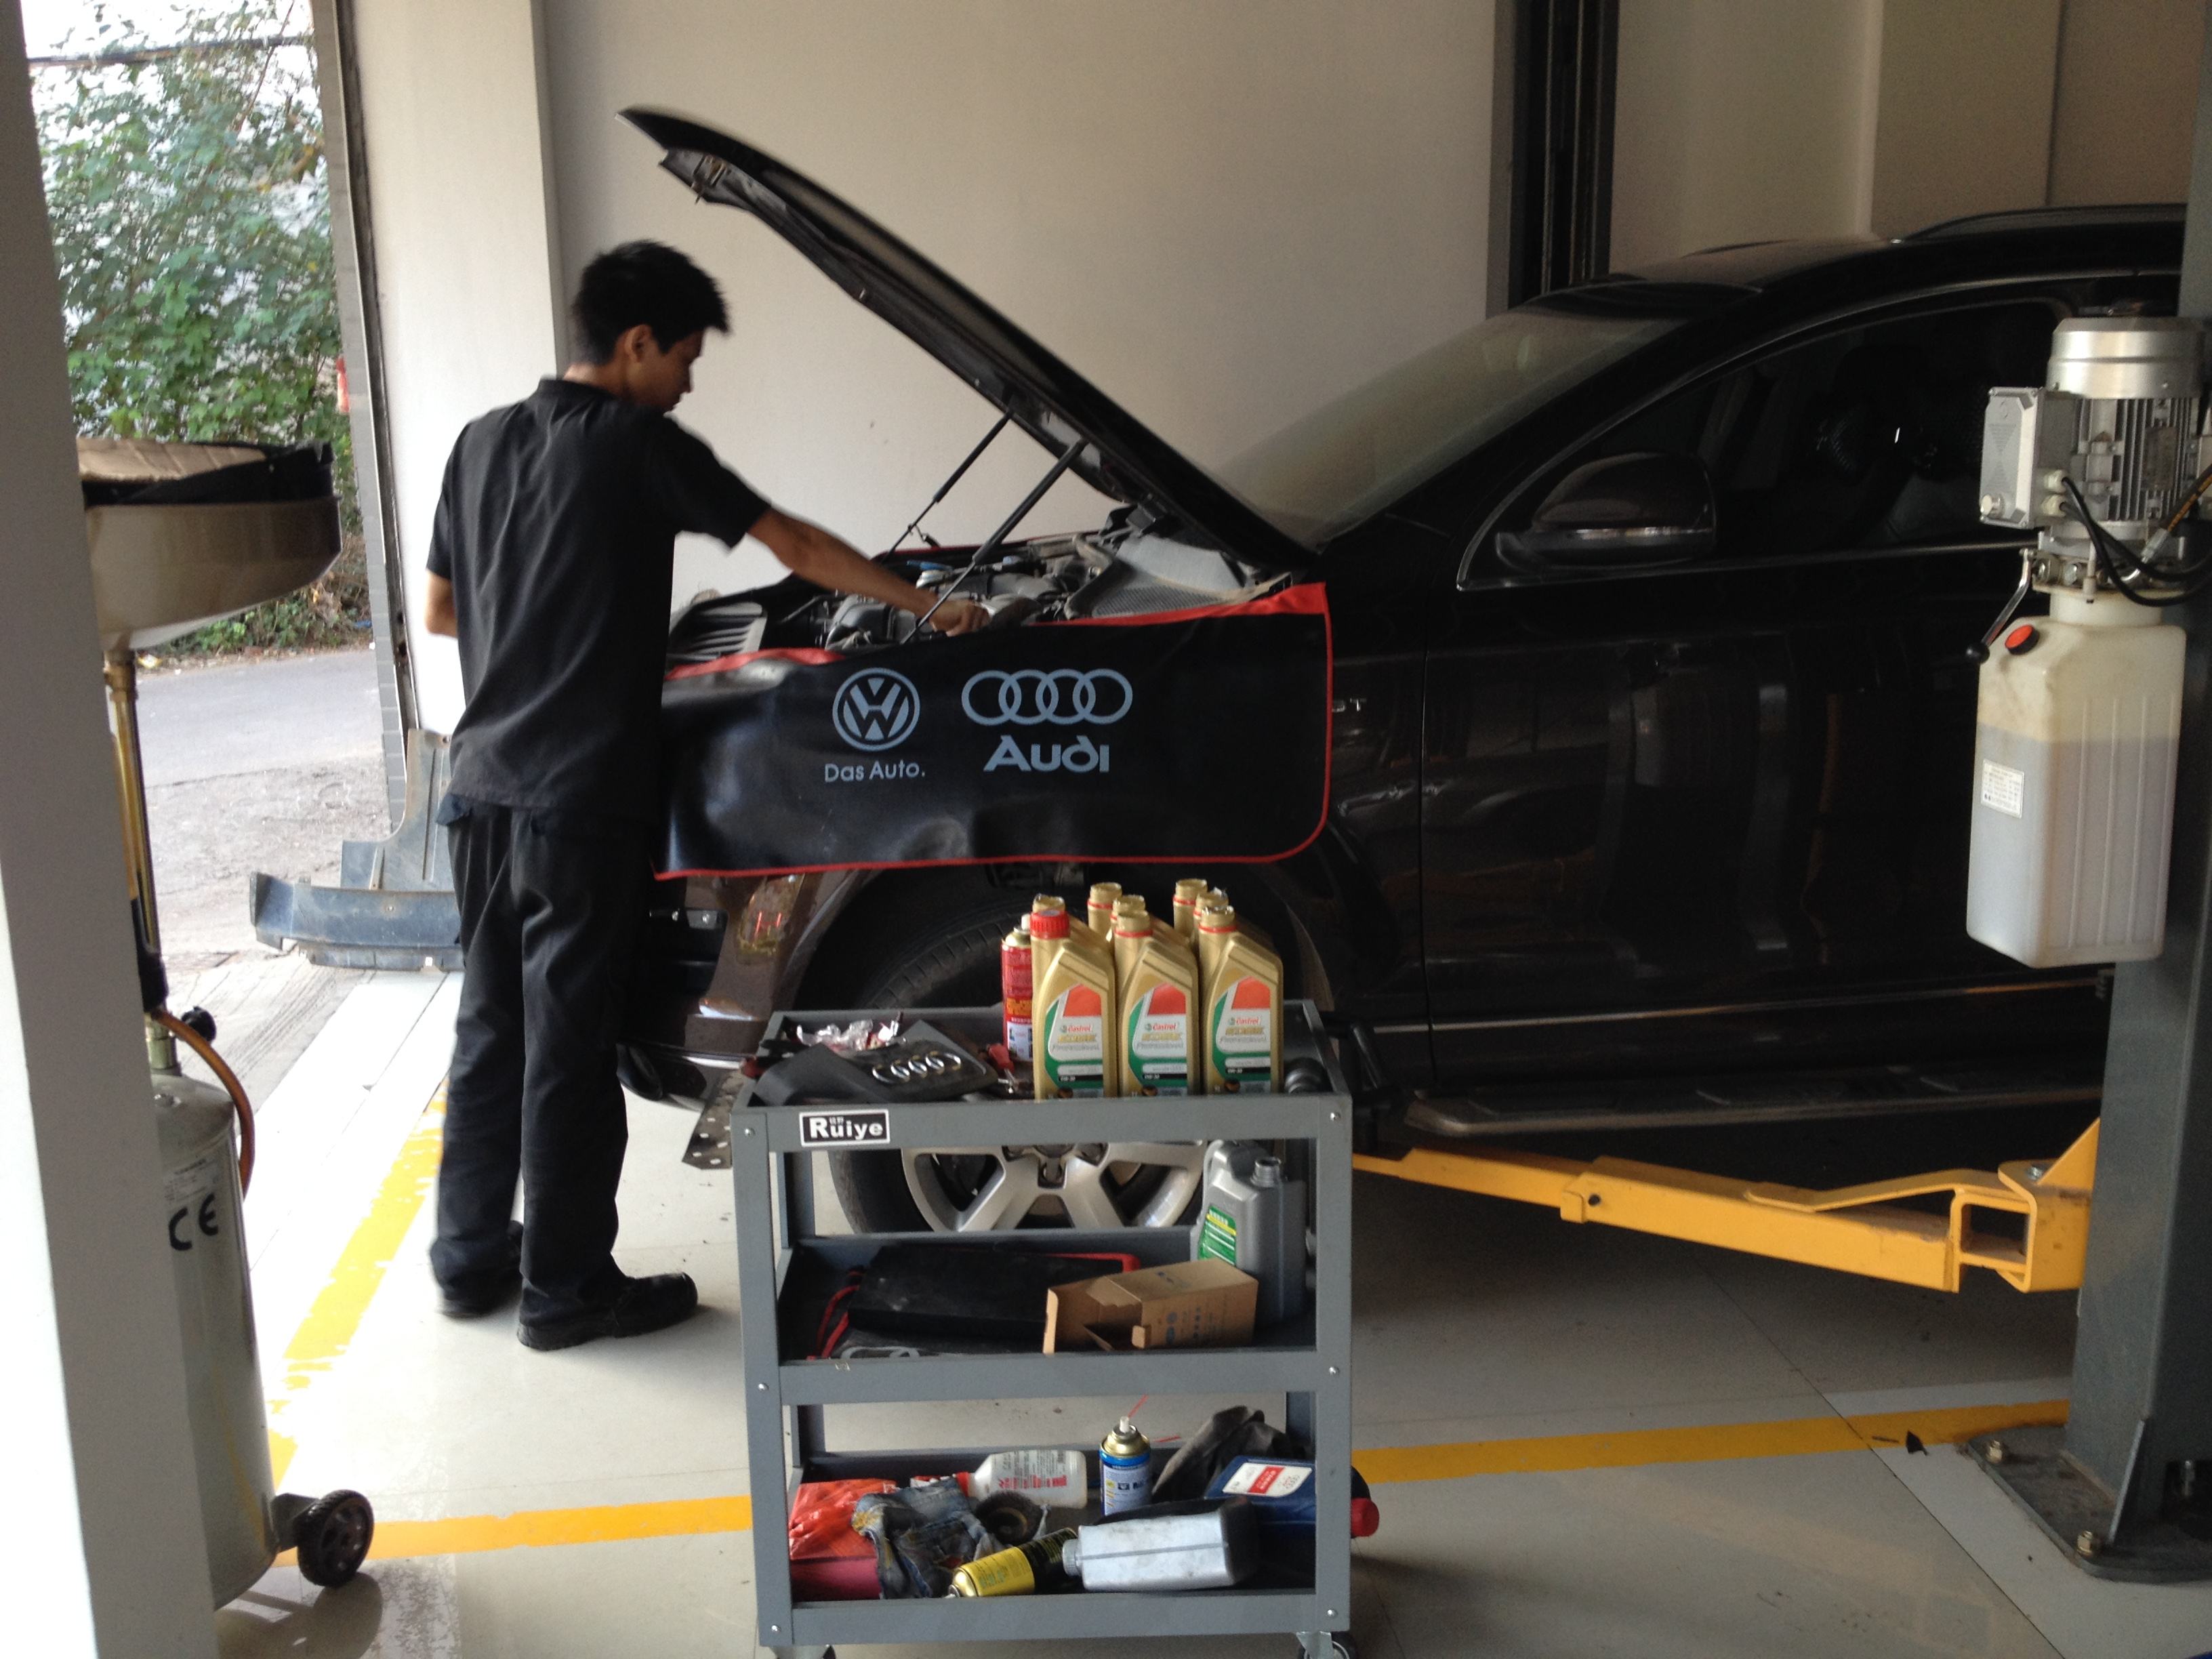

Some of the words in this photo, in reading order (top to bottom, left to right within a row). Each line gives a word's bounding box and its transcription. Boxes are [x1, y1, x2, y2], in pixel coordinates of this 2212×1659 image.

[824, 763, 864, 783] Das
[869, 760, 926, 780] Auto.
[983, 735, 1109, 773] Audi
[168, 1193, 219, 1251] CE
